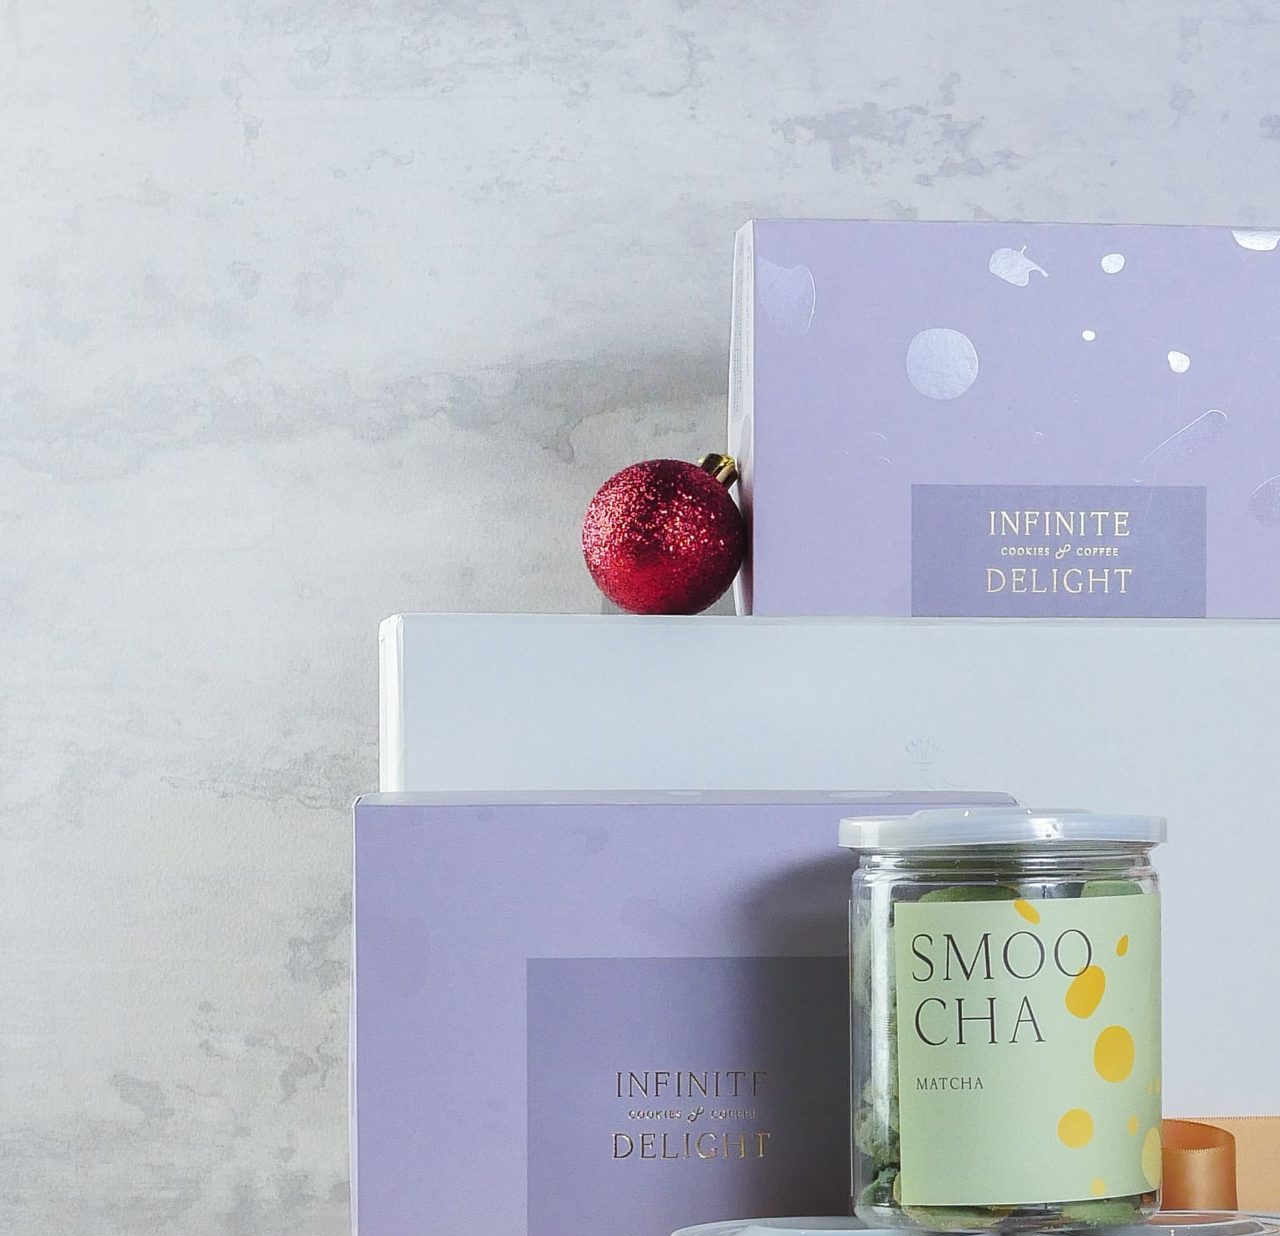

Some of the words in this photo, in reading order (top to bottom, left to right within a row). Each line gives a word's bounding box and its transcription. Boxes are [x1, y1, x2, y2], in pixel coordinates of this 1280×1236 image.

[989, 511, 1130, 536] INFINITE
[1001, 547, 1050, 556] COOKIES
[1076, 547, 1119, 556] COFFEE
[986, 568, 1133, 593] DELIGHT
[911, 929, 1093, 982] SMOO
[914, 995, 1046, 1046] CHA
[615, 1071, 768, 1098] INFINITE
[915, 1076, 984, 1090] MATCHA
[628, 1109, 682, 1120] COOKIES
[611, 1131, 771, 1160] DELIGHT
